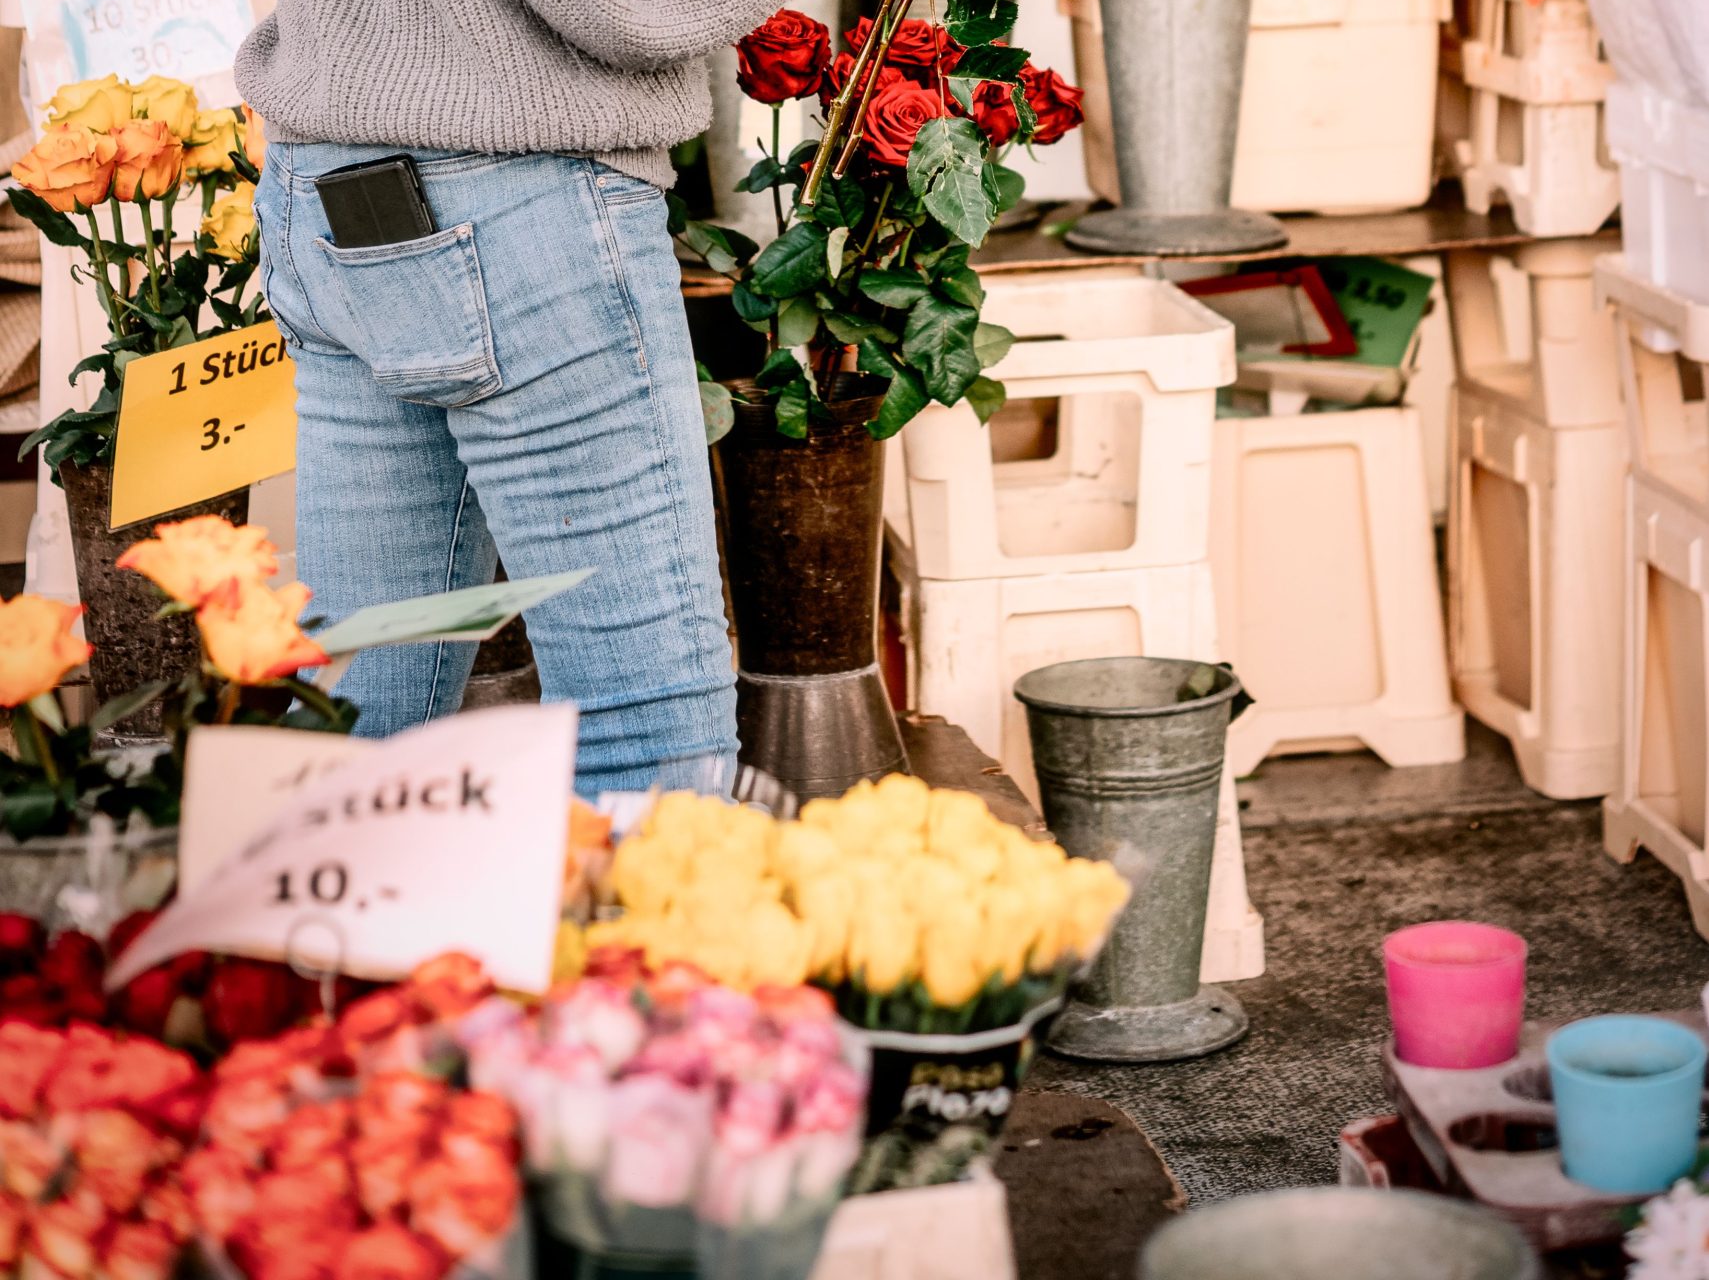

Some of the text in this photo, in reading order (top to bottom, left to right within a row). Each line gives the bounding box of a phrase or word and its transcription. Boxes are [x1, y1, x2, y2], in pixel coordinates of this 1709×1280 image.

[83, 0, 125, 34] 10
[168, 361, 188, 396] 1
[200, 417, 246, 452] 3.-
